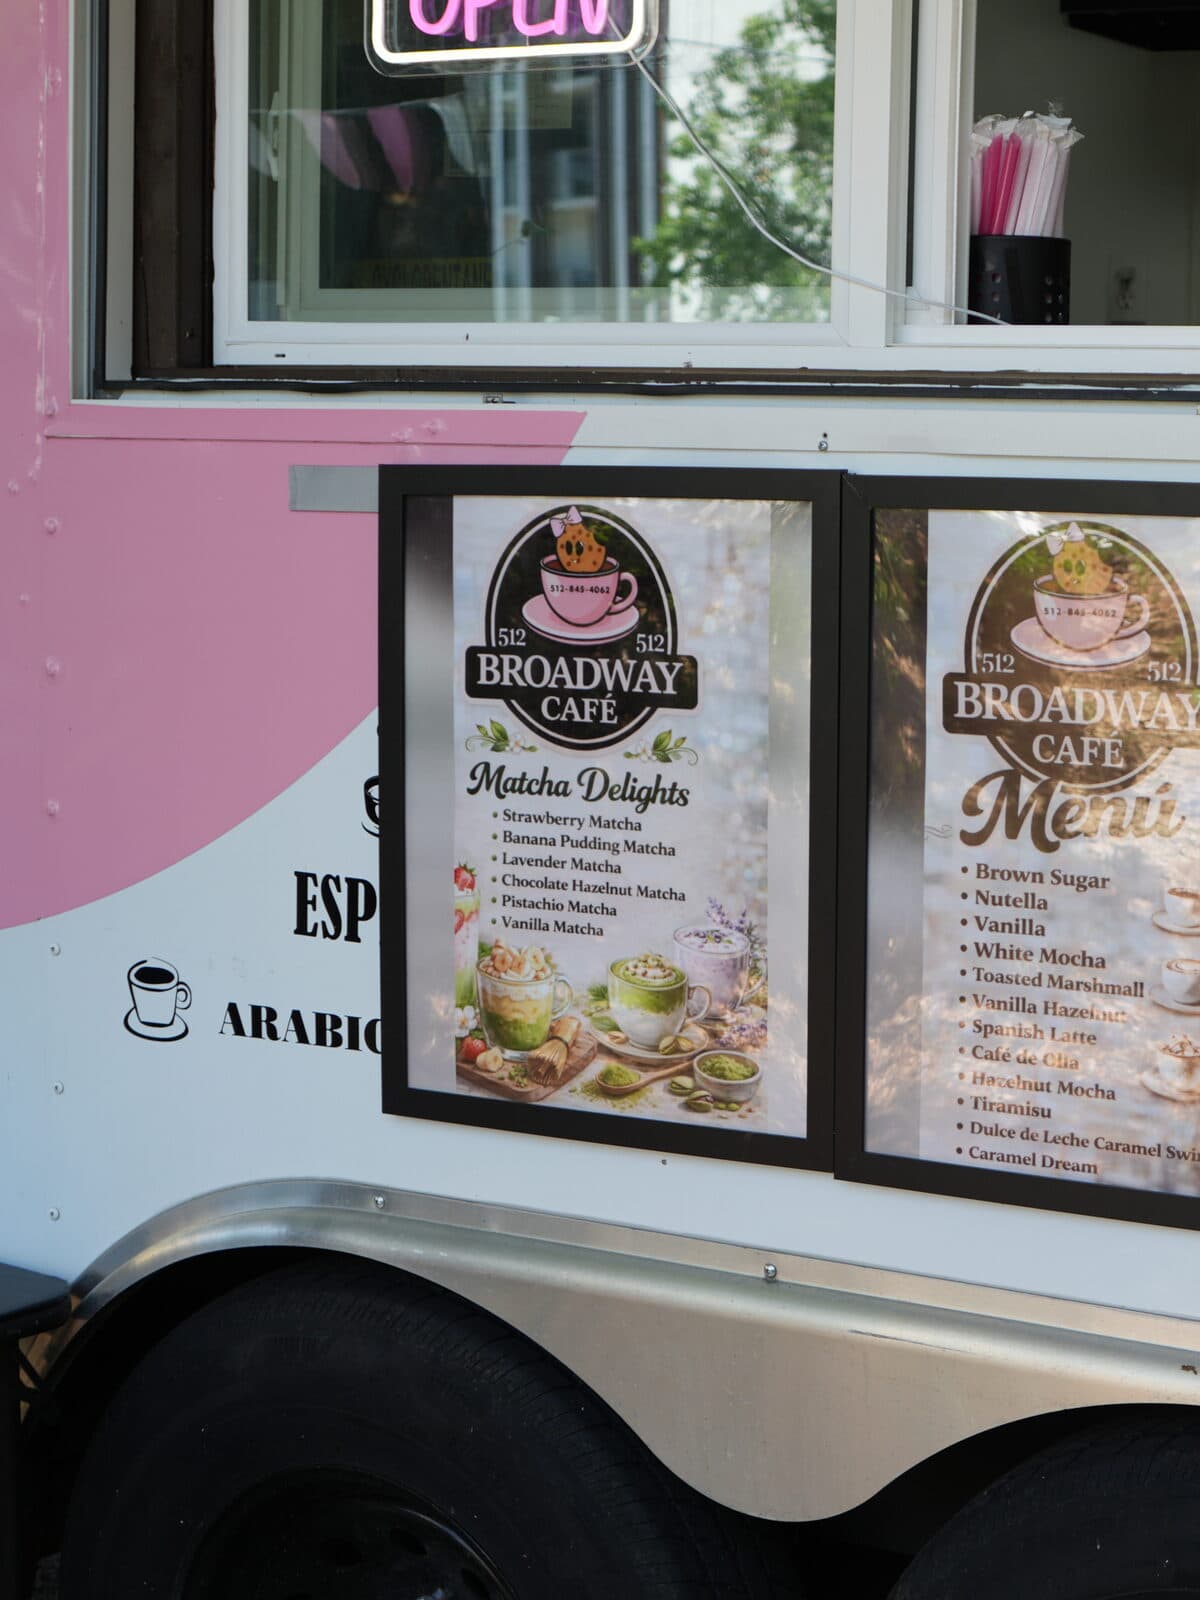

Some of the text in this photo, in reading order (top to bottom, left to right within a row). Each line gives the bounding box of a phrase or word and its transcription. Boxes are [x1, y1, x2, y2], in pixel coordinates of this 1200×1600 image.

[498, 628, 527, 647] 512
[636, 634, 665, 653] 512
[477, 653, 683, 695] BROADWAY
[981, 654, 1015, 674] 512
[1147, 662, 1182, 682] 512
[541, 694, 618, 724] CAFÉ
[1032, 731, 1124, 768] CAFÉ
[466, 761, 690, 814] Matcha Delights
[502, 809, 642, 832] Strawberry Matcha
[502, 831, 676, 857] Banana Pudding Matcha
[502, 852, 622, 874] Lavender Matcha
[502, 874, 686, 902] Chocolate Hazelnut Matcha
[976, 863, 1110, 892] Brown Sugar
[502, 895, 617, 916] Pistachio Matcha
[975, 890, 1048, 910] Nutella
[501, 916, 604, 937] Vanilla Matcha
[974, 916, 1046, 936] Vanilla
[974, 942, 1106, 969] White Mocha
[973, 967, 1042, 987] Toasted
[972, 994, 1037, 1014] Vanilla
[972, 1020, 1097, 1046] Spanish Latte
[972, 1045, 1010, 1062] Café
[1016, 1047, 1038, 1066] de
[972, 1072, 1116, 1101] Hazelnut Mocha
[971, 1096, 1052, 1119] Tiramisu
[970, 1122, 1016, 1139] Dulce
[1020, 1127, 1039, 1142] de
[1044, 1131, 1090, 1148] Leche
[1094, 1136, 1162, 1158] Caramel
[969, 1146, 1098, 1174] Caramel Dream
